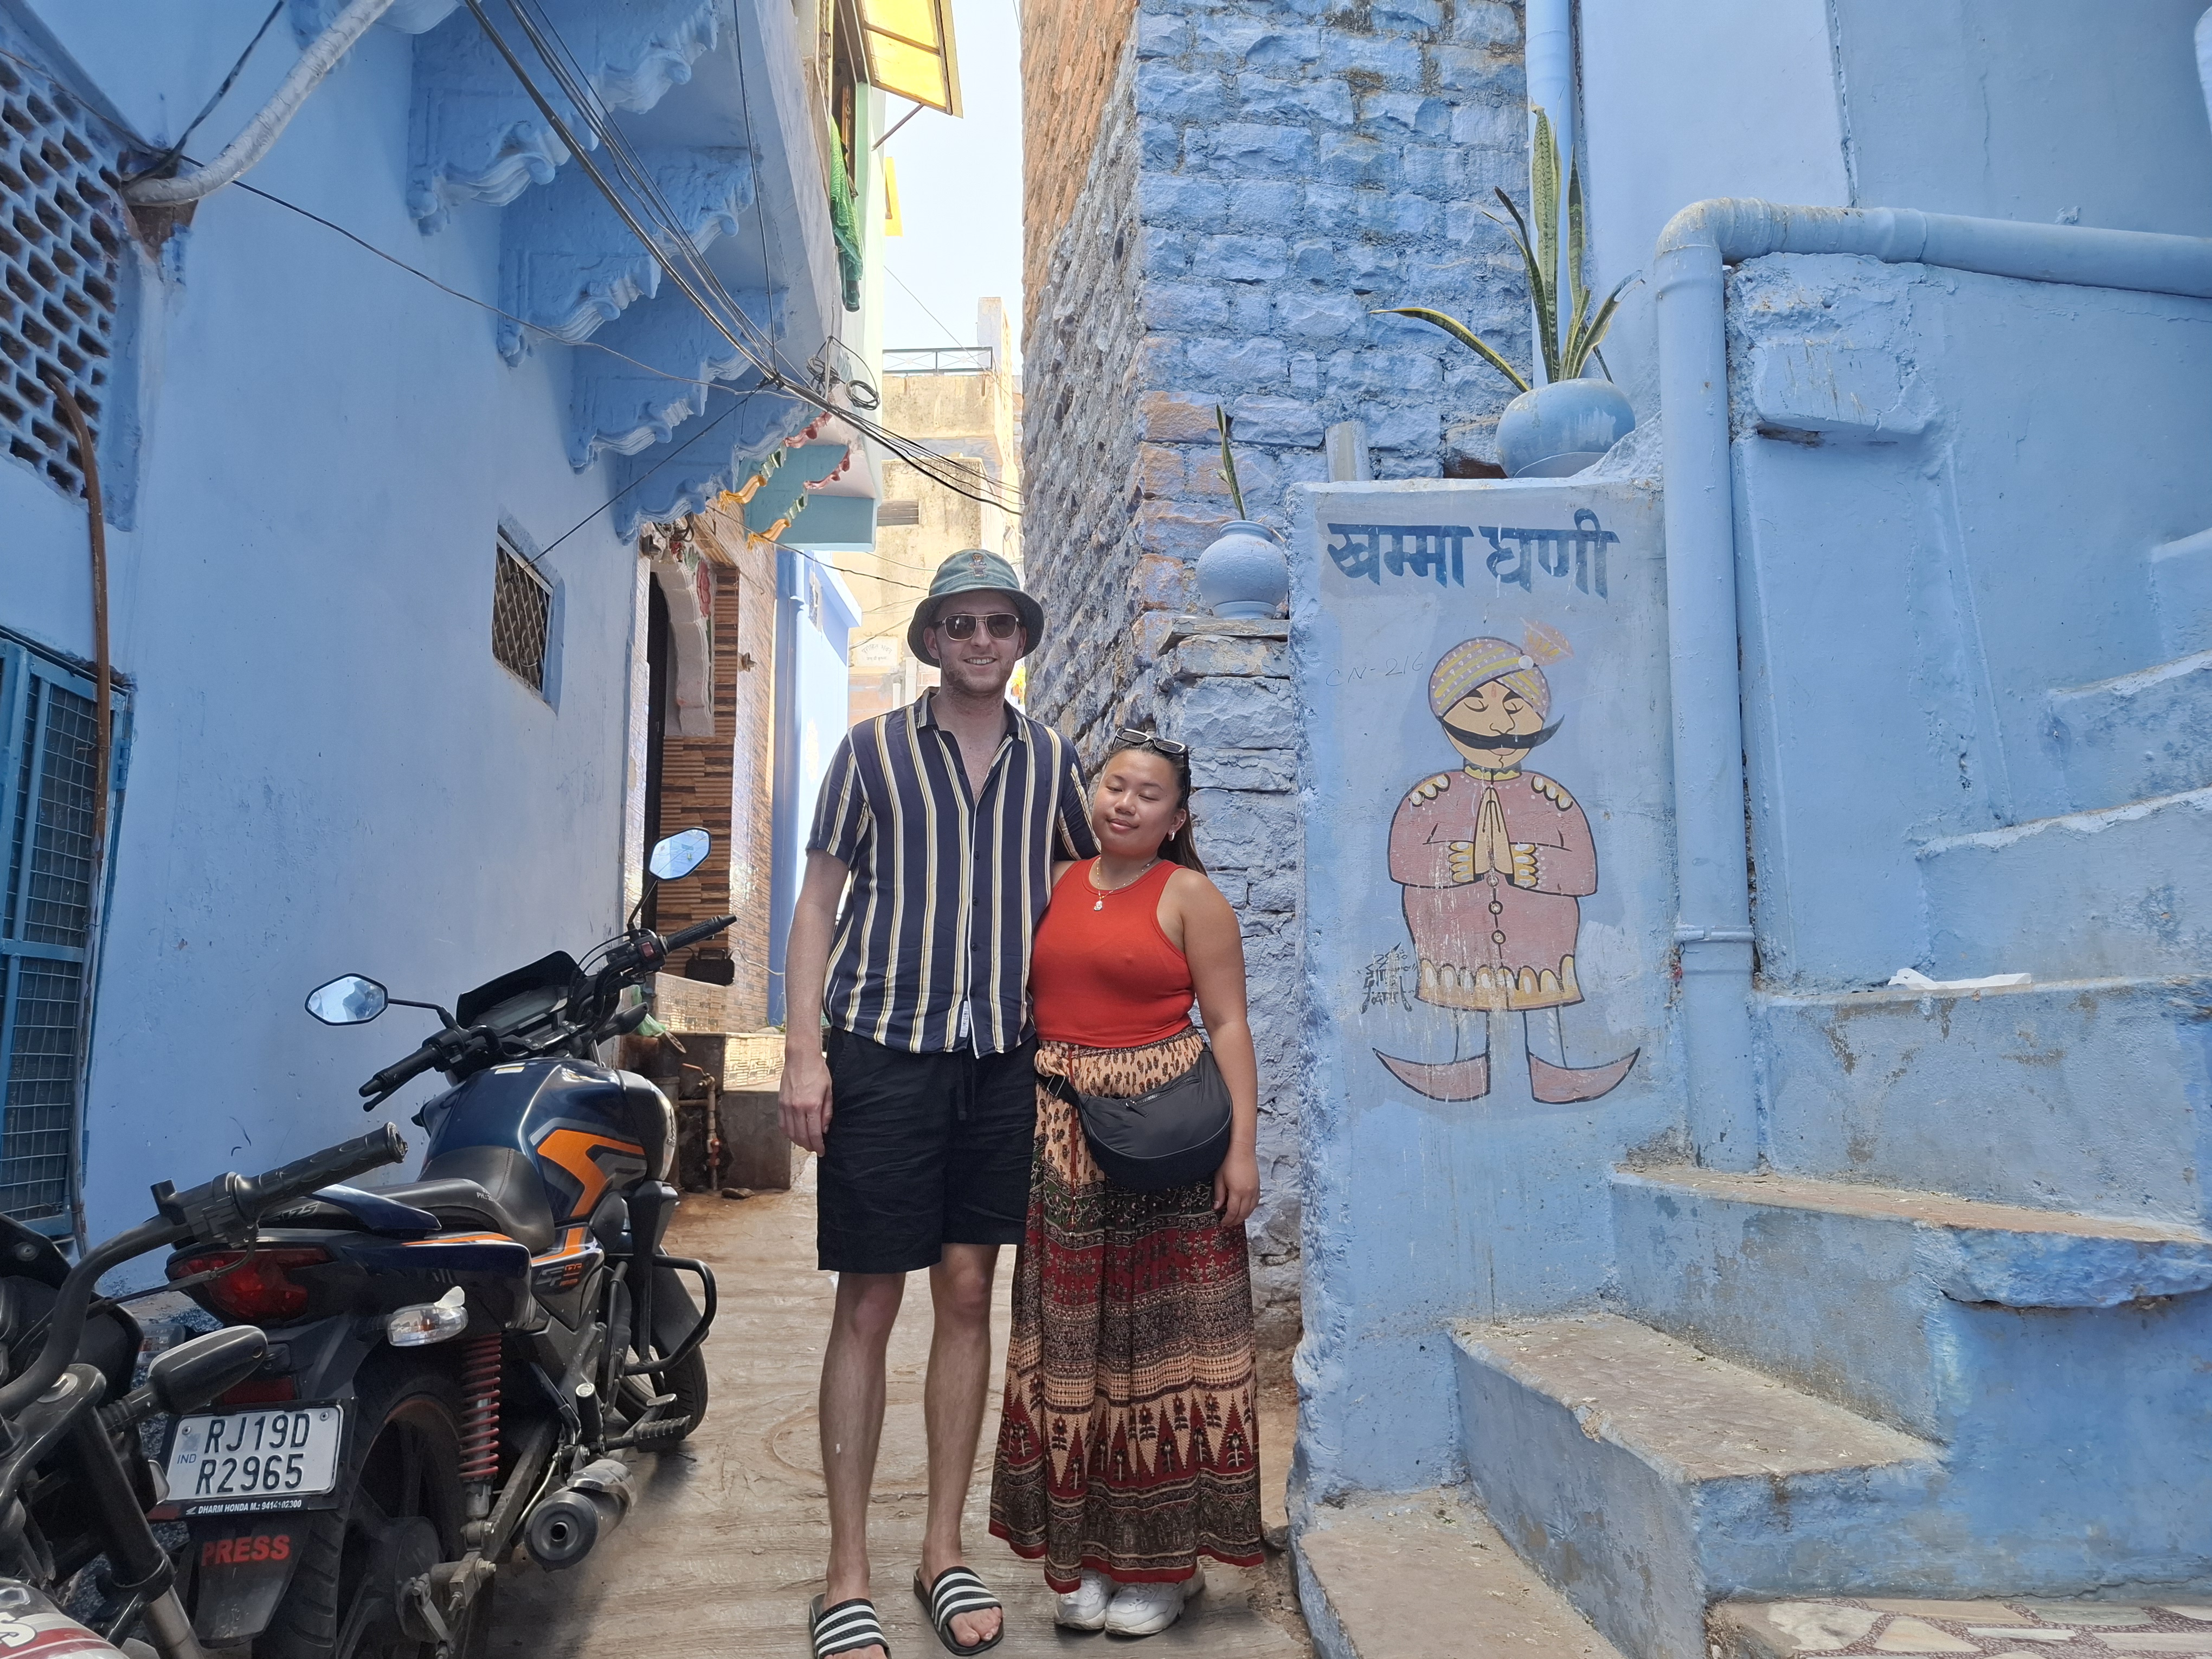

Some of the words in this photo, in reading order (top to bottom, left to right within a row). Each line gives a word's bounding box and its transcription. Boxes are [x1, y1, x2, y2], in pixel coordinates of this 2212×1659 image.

[1326, 523, 1474, 589] खम्मा
[1478, 507, 1621, 603] घणी
[204, 1413, 311, 1455] RJ19D
[177, 1454, 197, 1464] IND
[195, 1453, 305, 1495] R2965
[198, 1504, 223, 1514] DHARM
[224, 1503, 248, 1513] HONDA
[201, 1534, 291, 1567] PRESS
